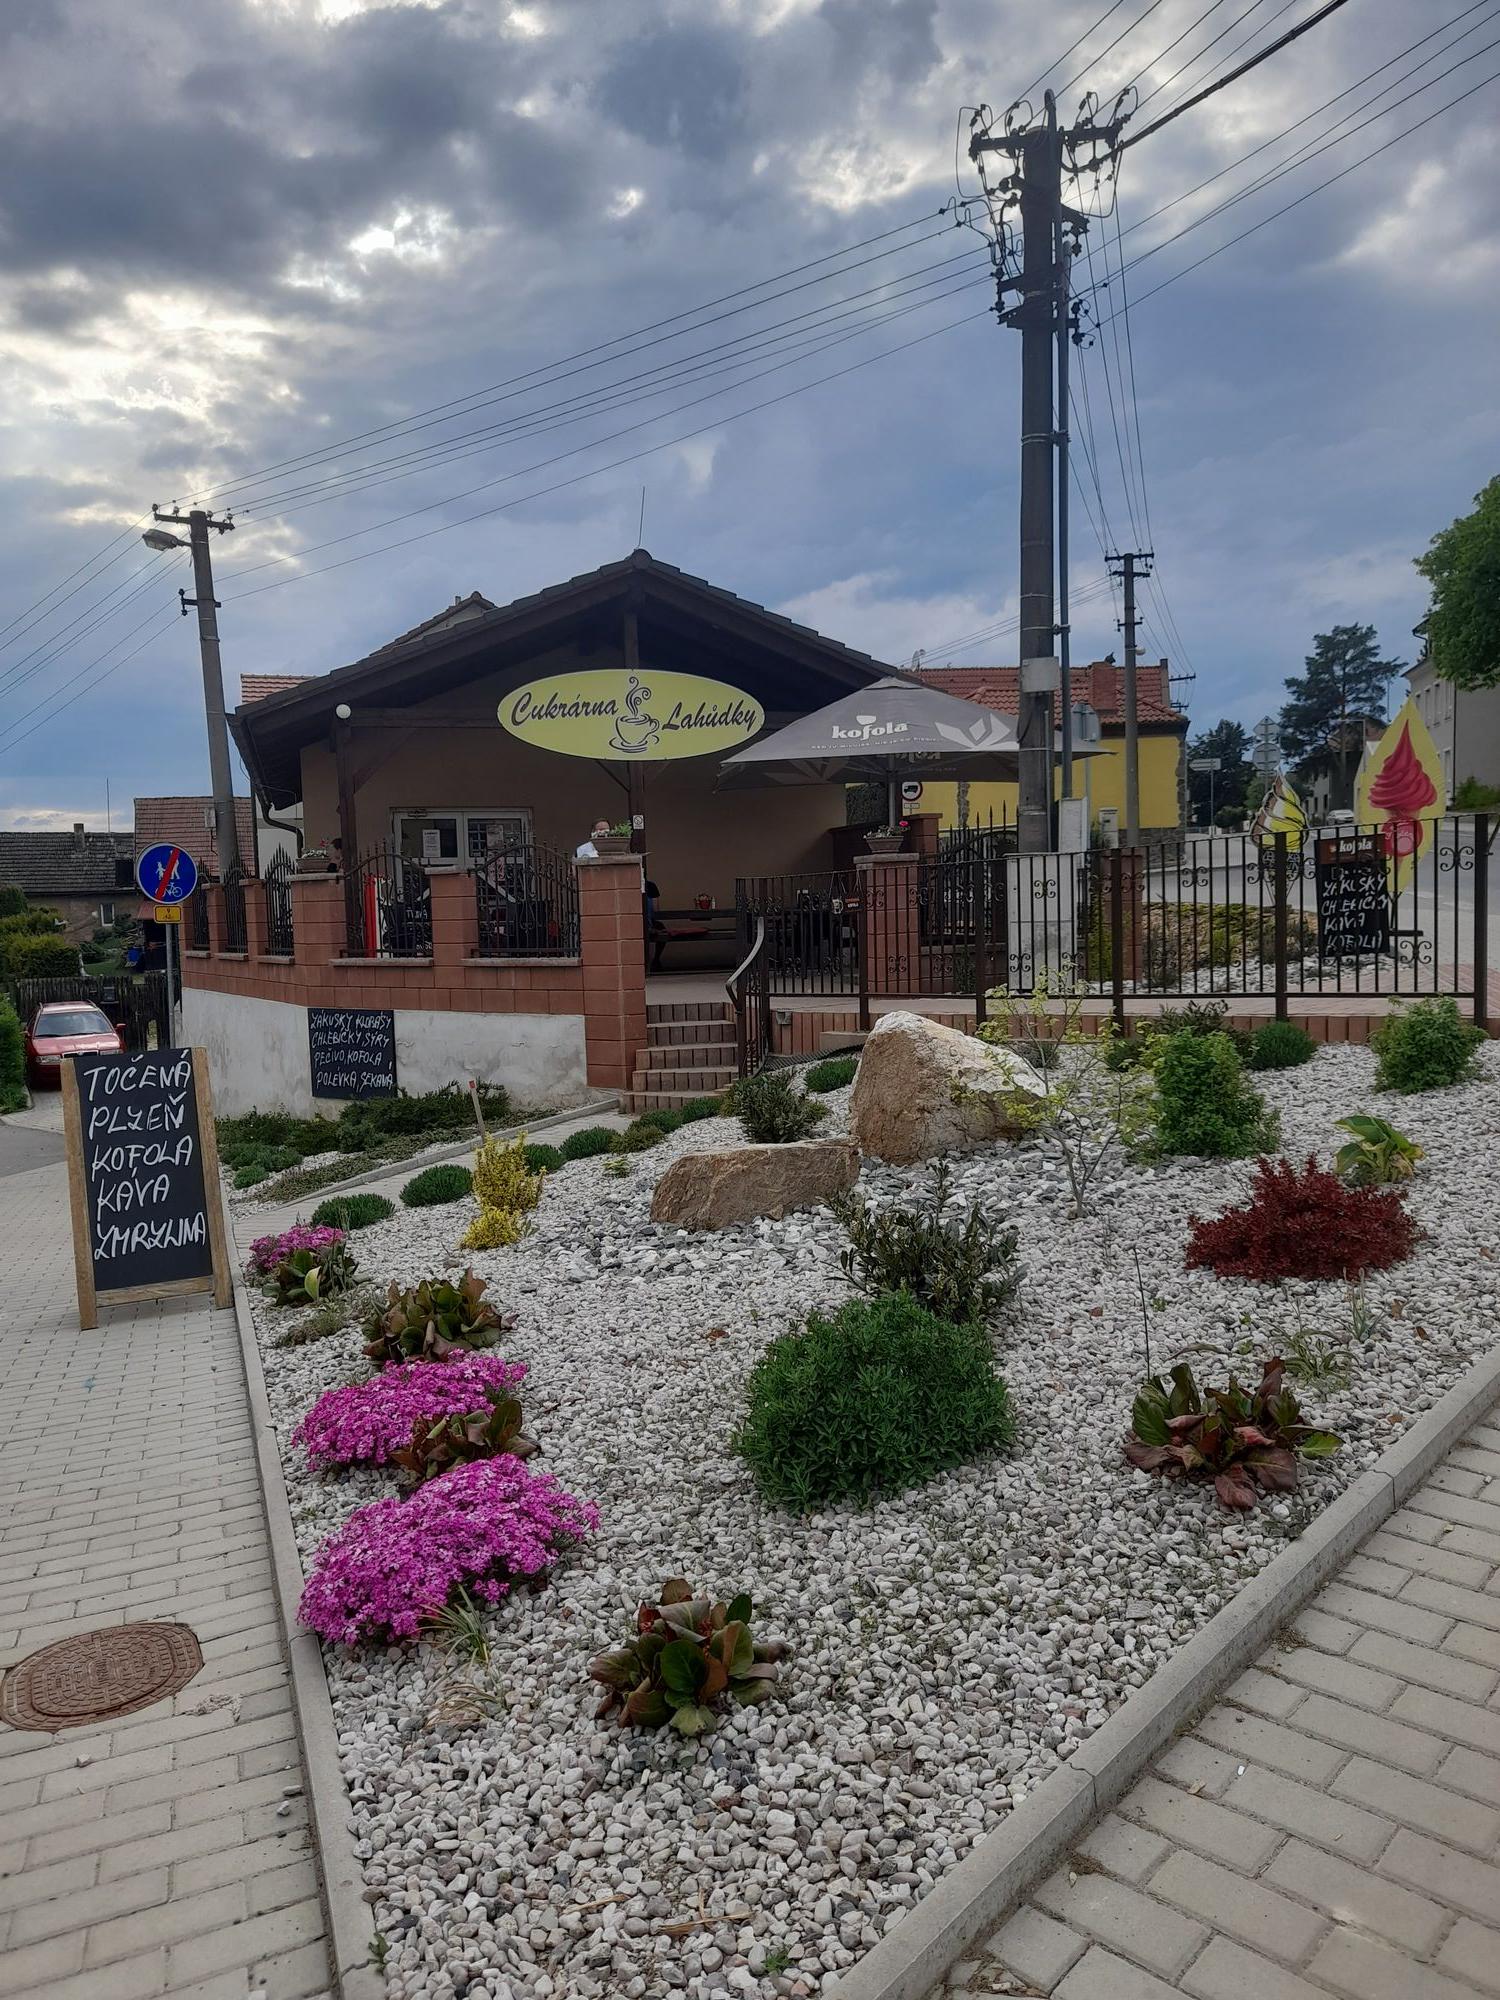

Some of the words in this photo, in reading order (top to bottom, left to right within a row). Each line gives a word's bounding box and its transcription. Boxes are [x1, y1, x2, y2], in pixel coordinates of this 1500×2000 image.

[511, 692, 620, 727] Cukrárna
[661, 700, 757, 732] Lahůdky
[831, 721, 909, 741] kofola
[310, 1009, 353, 1031] ZÁKUSKY
[83, 1050, 192, 1102] TOČENÁ
[88, 1091, 188, 1141] PLZEŇ
[91, 1135, 193, 1182] KOFOLA
[97, 1168, 171, 1222] KÁVA
[94, 1211, 207, 1260] ZMRZLINA
